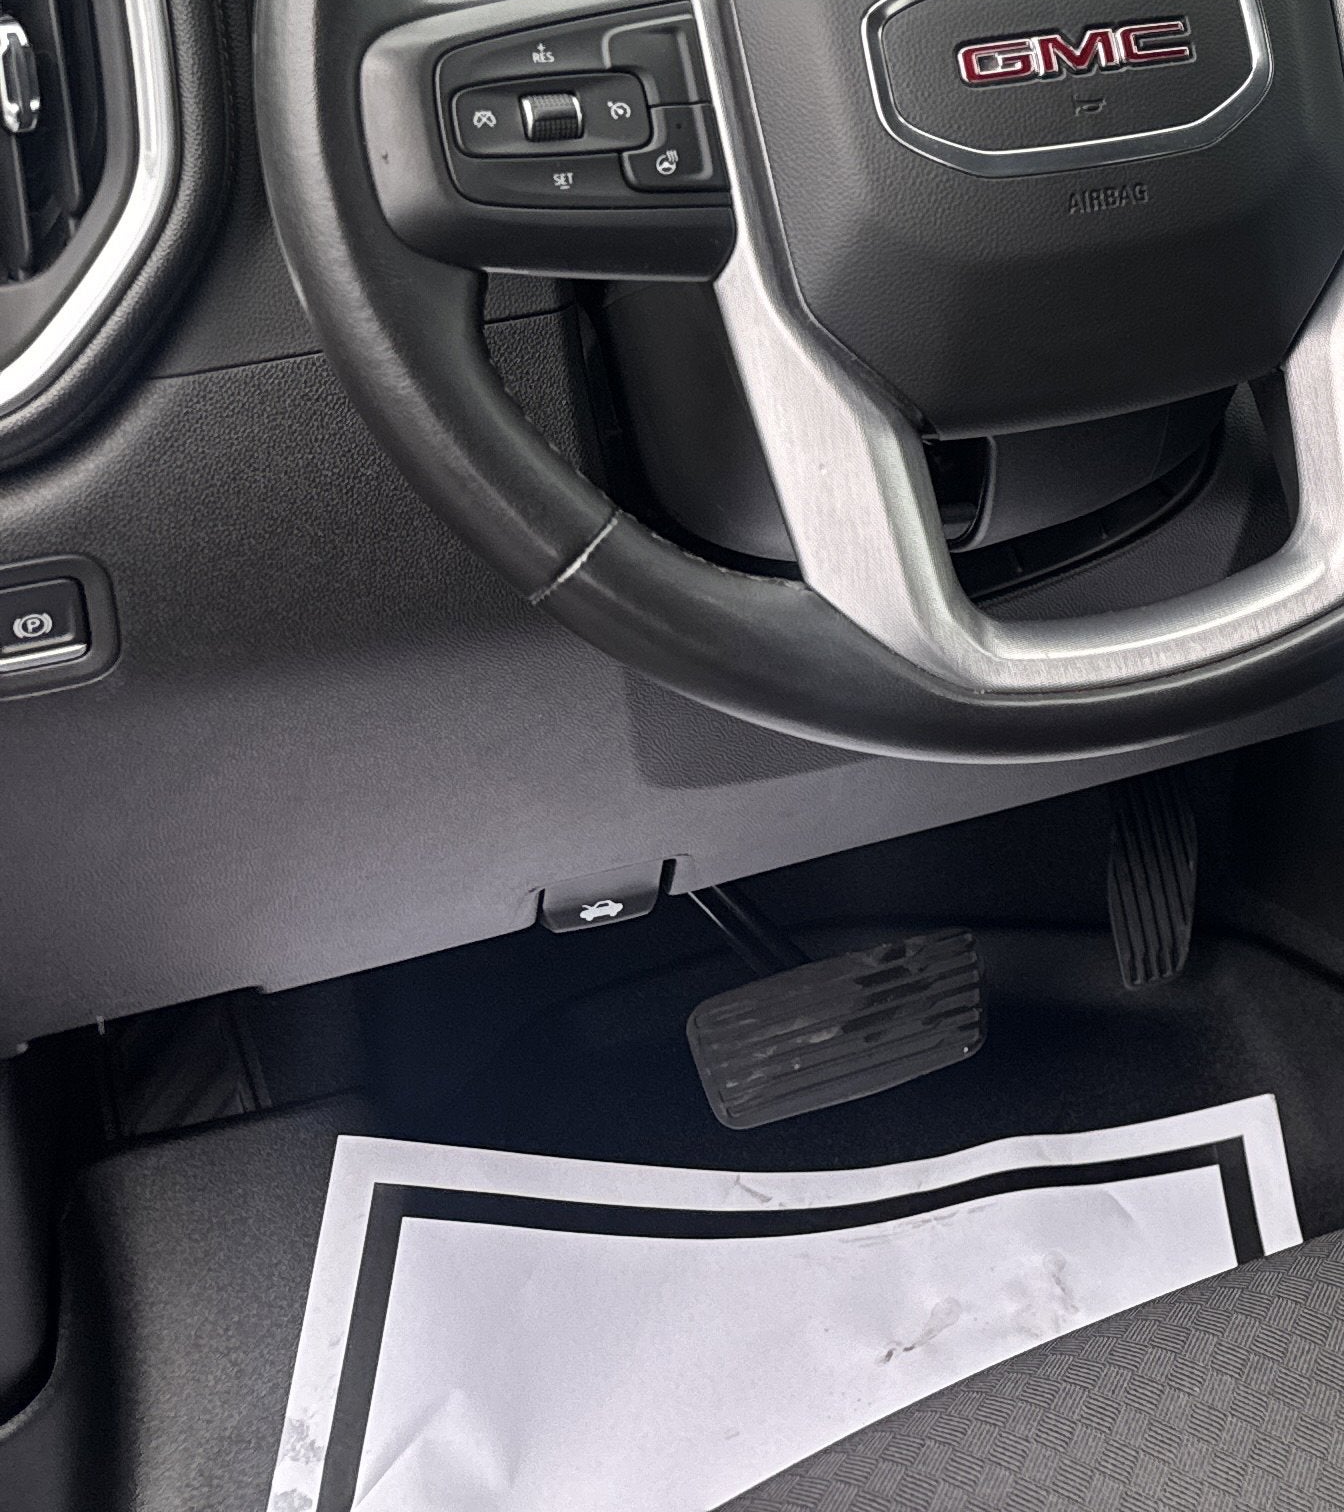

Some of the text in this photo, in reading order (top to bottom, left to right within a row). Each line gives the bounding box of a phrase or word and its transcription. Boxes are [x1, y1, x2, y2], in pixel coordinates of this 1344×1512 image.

[532, 51, 554, 63] RES
[957, 20, 1191, 85] GMC
[553, 173, 573, 186] SET
[1068, 182, 1149, 215] AIRBAG
